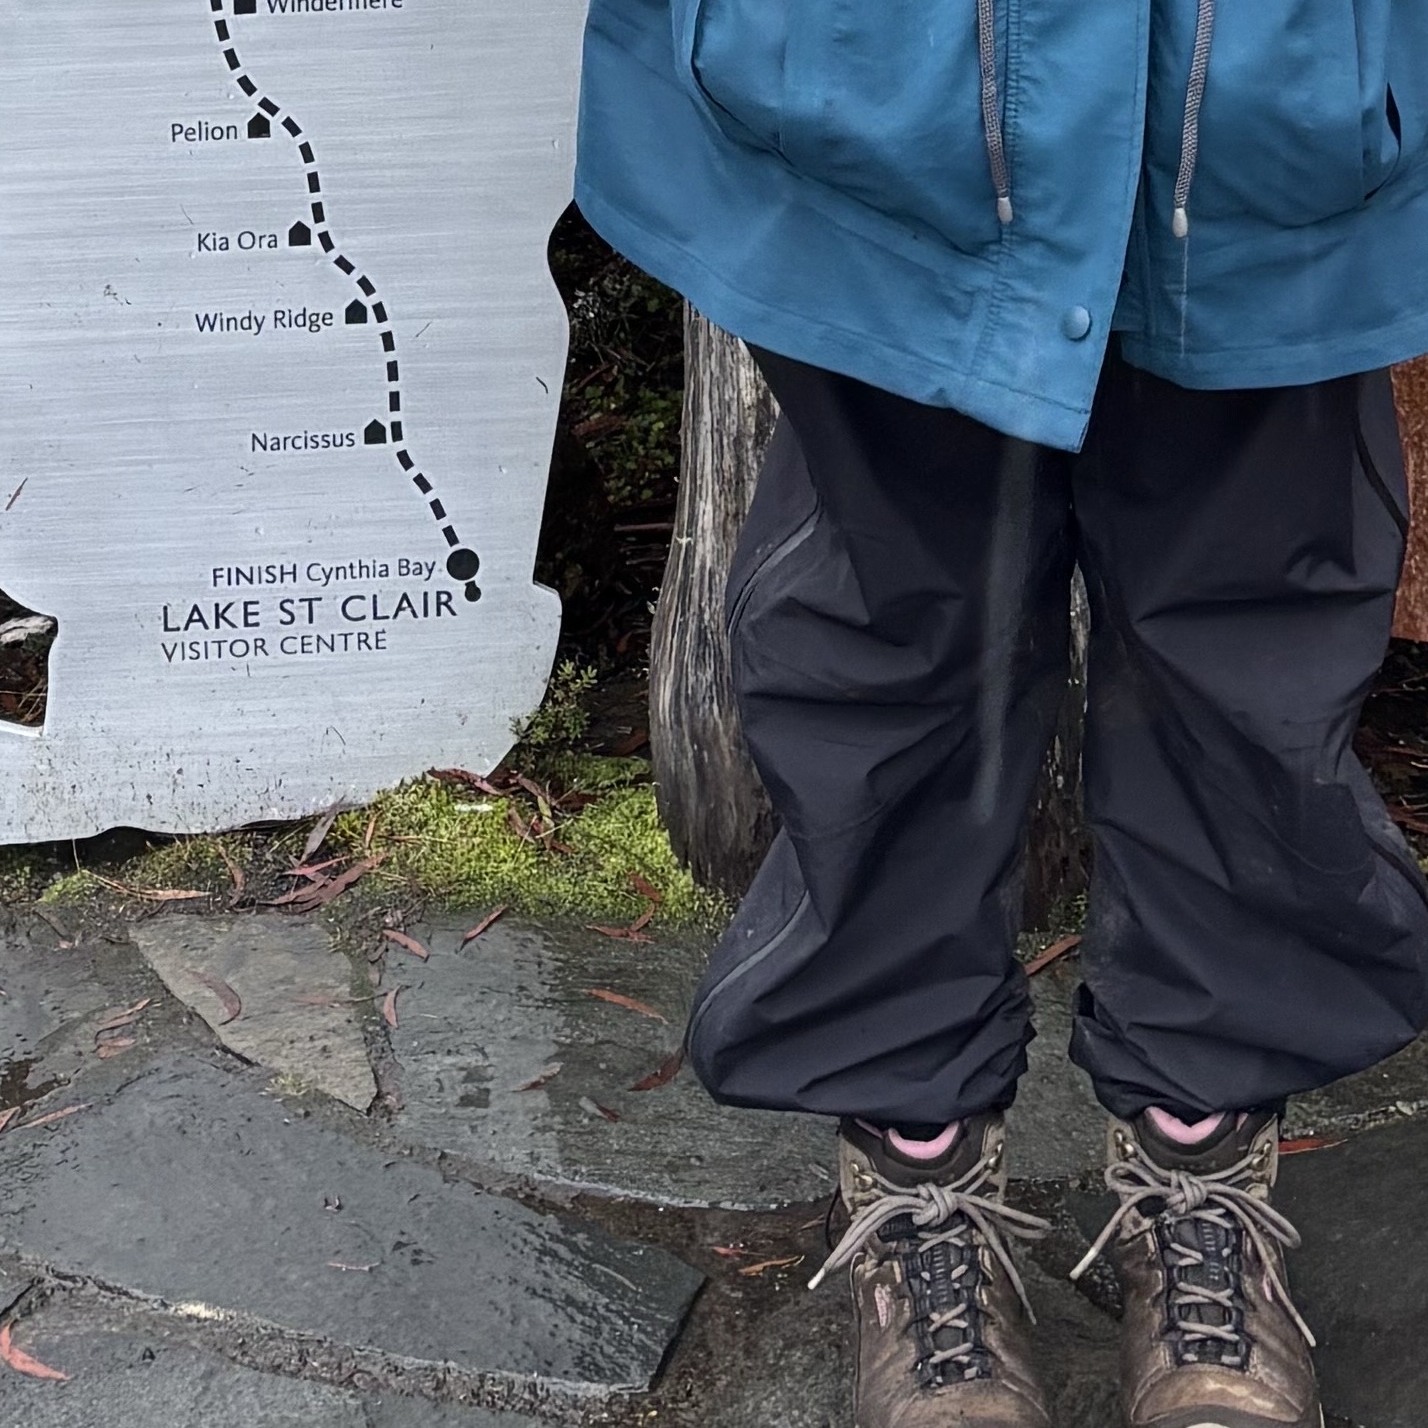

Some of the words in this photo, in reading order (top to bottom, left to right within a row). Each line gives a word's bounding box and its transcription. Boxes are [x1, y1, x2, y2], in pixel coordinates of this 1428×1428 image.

[171, 120, 238, 143] Pelion
[197, 232, 230, 252] Kia
[237, 230, 278, 250] Ora
[195, 310, 266, 336] Windy
[273, 306, 334, 333] Ridge
[251, 432, 356, 453] Narcissus
[212, 563, 297, 588] FINISH
[306, 559, 390, 587] Cynthia
[398, 558, 436, 582] Bay
[162, 600, 261, 633] LAKE
[279, 596, 323, 626] ST
[341, 590, 458, 622] CLAIR
[161, 637, 269, 663] VISITOR
[280, 628, 387, 655] CENTRE
